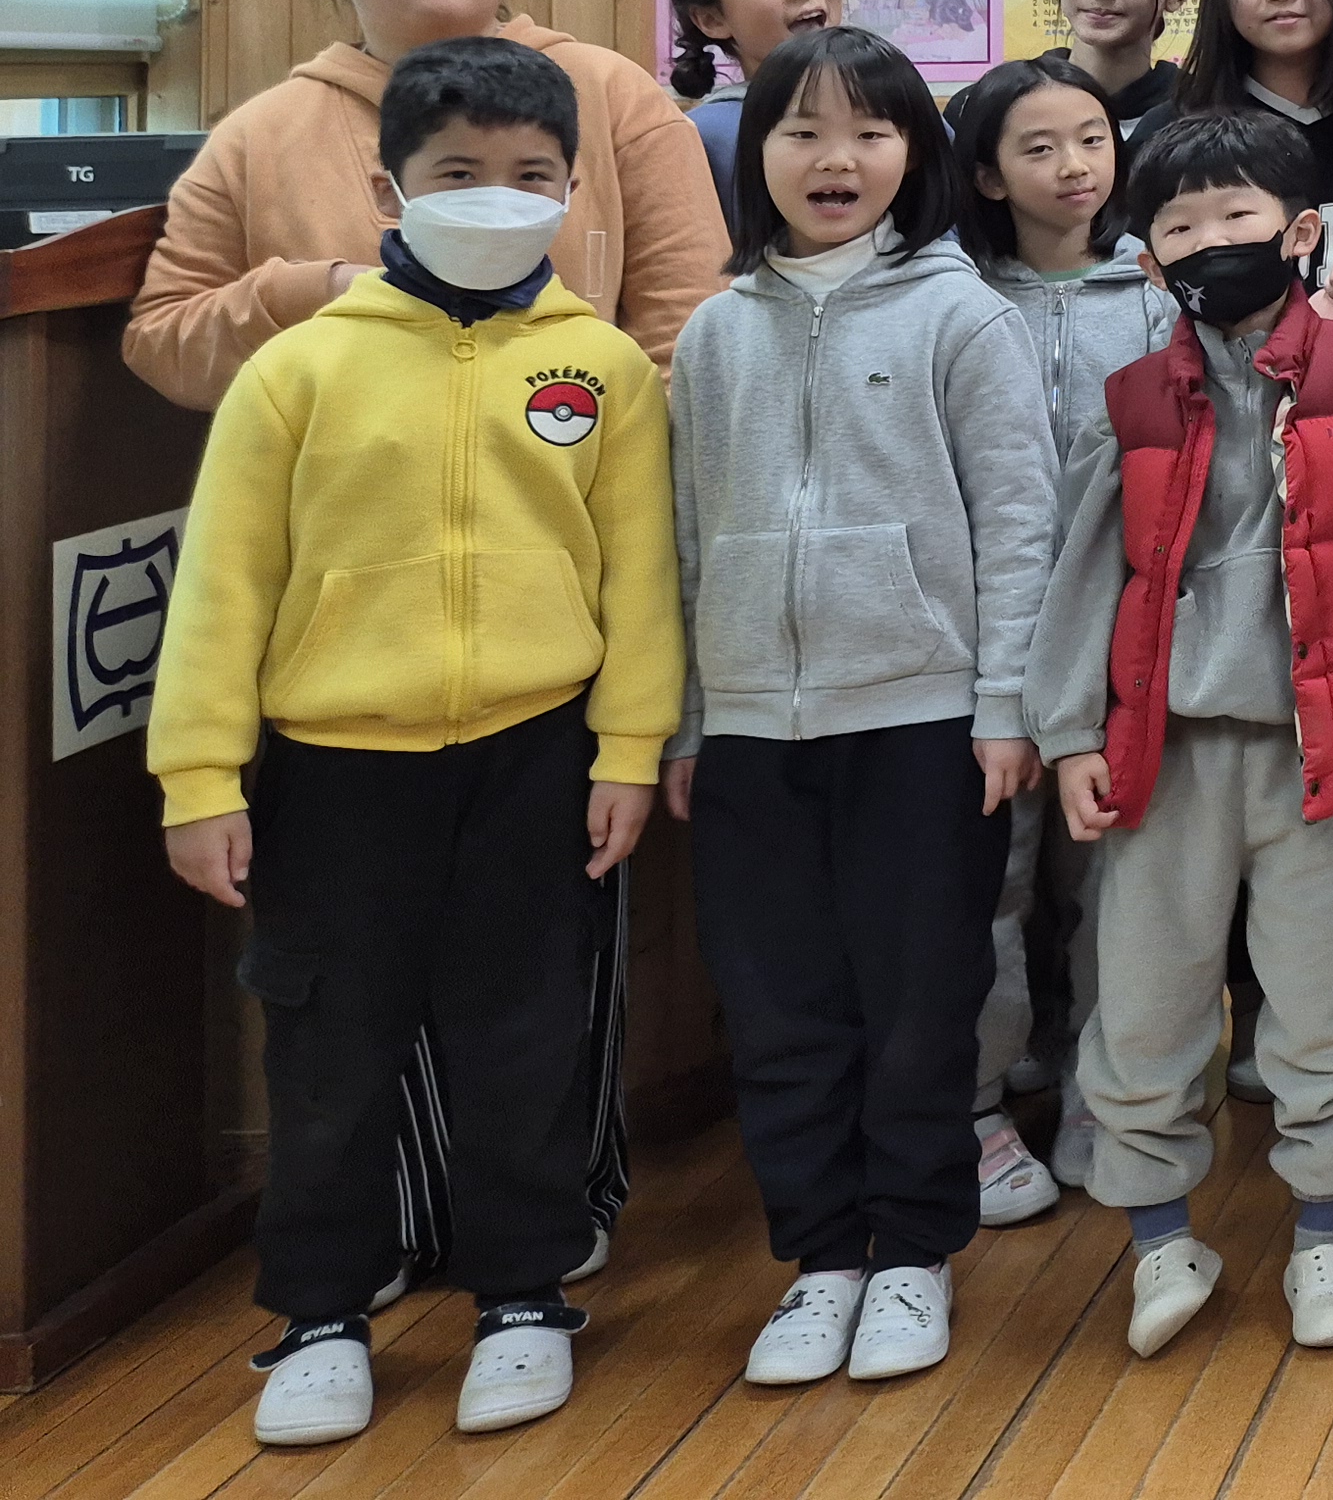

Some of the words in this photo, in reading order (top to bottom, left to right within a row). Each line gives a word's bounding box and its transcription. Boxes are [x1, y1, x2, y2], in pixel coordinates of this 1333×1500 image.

[67, 166, 94, 182] TG
[525, 365, 607, 397] POKÉMON
[501, 1311, 544, 1325] RYAN
[301, 1322, 345, 1343] RYAN
